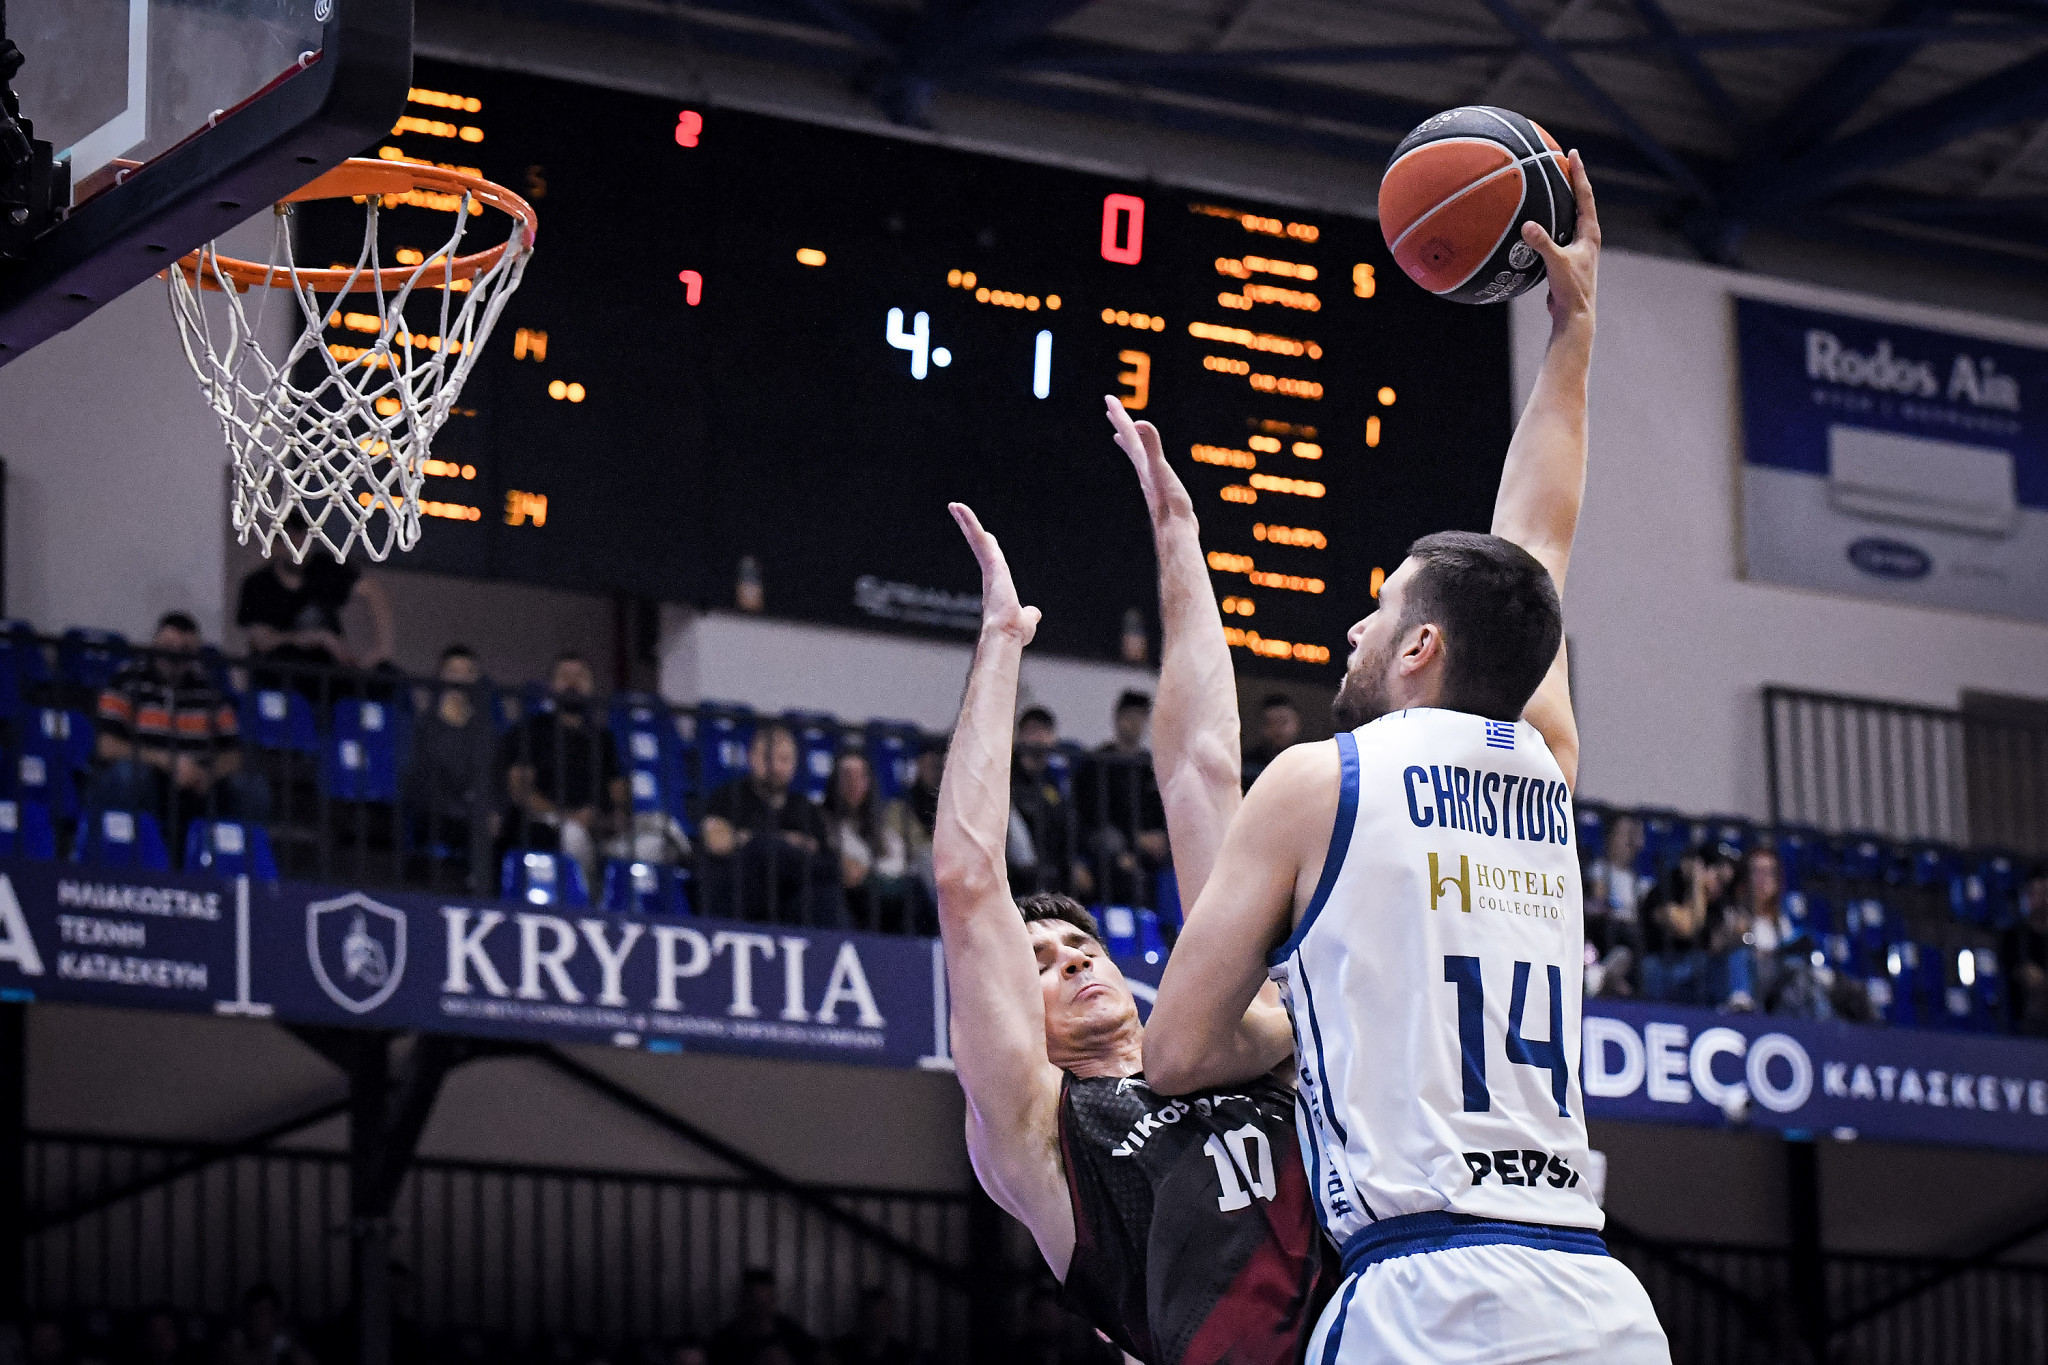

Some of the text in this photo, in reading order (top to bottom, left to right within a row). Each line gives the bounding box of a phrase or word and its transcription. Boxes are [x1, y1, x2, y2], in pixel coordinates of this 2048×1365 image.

[1101, 193, 1145, 265] 0
[1806, 329, 1939, 398] Rodos
[1946, 354, 2021, 413] Air
[1403, 765, 1568, 845] CHRISTIDIS
[1476, 864, 1564, 899] HOTELS
[440, 906, 886, 1028] KRYPTIA
[1444, 955, 1571, 1117] 14
[1111, 1098, 1190, 1157] VIKOS
[1203, 1123, 1277, 1212] 10
